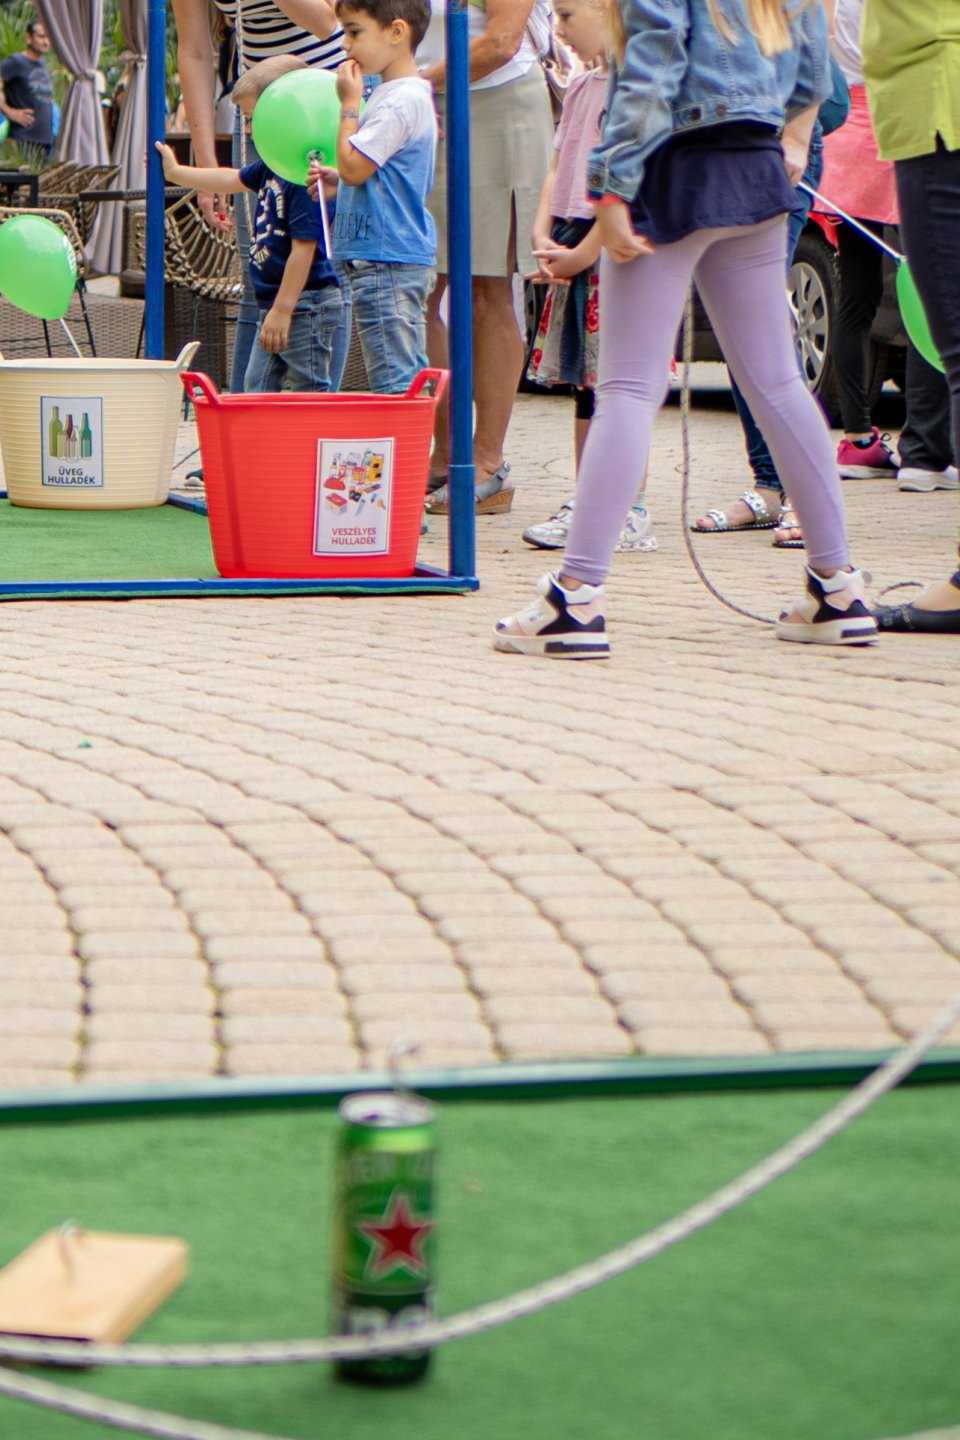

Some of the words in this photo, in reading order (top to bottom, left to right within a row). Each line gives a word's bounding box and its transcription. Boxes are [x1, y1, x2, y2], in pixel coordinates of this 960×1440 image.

[335, 212, 371, 241] ELIEVE
[58, 466, 83, 476] ÜVEG
[48, 474, 95, 485] HULLADÉK
[332, 526, 377, 536] VESZÉLYES
[331, 536, 376, 546] HULLADÉK
